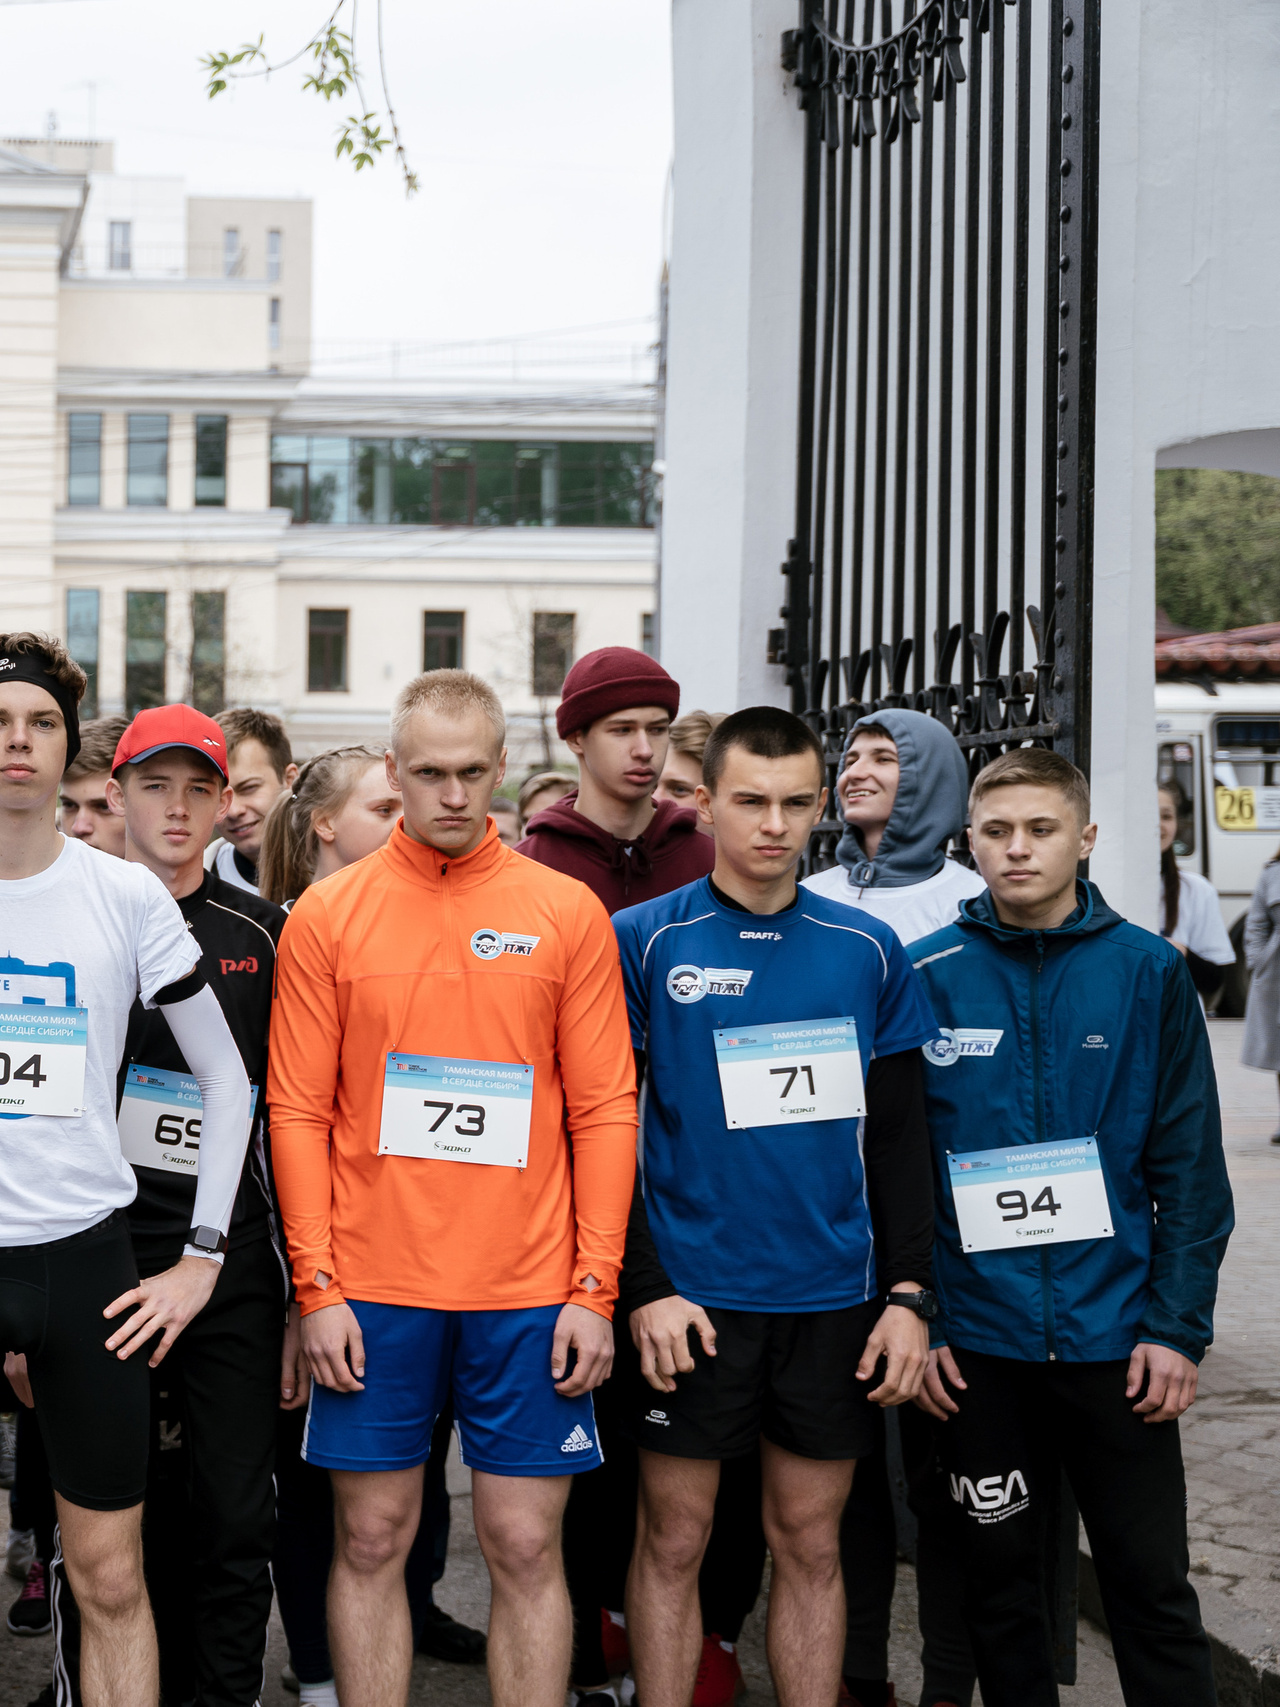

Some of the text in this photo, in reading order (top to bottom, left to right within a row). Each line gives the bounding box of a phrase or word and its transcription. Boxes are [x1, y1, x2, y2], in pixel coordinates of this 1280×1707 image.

[1221, 792, 1255, 821] 26
[740, 931, 774, 940] CRAFT
[50, 1015, 77, 1026] МИЛЯ
[0, 1026, 36, 1036] СЕРДЦЕ
[37, 1028, 74, 1037] СИБИРИ
[772, 1026, 847, 1040] ТАМАНСКАЯ МИЛЯ
[780, 1040, 812, 1050] СЕРДЦЕ
[813, 1037, 846, 1047] СИБИРИ
[444, 1065, 522, 1080] ТАМАНСКАЯ МИЛЯ
[449, 1078, 483, 1089] СЕРДЦЕ
[485, 1081, 519, 1091] СИБИРИ
[769, 1065, 816, 1099] 71
[423, 1100, 486, 1137] 73
[1006, 1146, 1086, 1162] ТАМАНСКАЯ МИЛЯ
[1007, 1157, 1086, 1173] В СЕРДЦЕ СИБИРИ
[996, 1186, 1062, 1222] 94
[560, 1440, 593, 1452] adidas
[949, 1469, 1029, 1509] NASA
